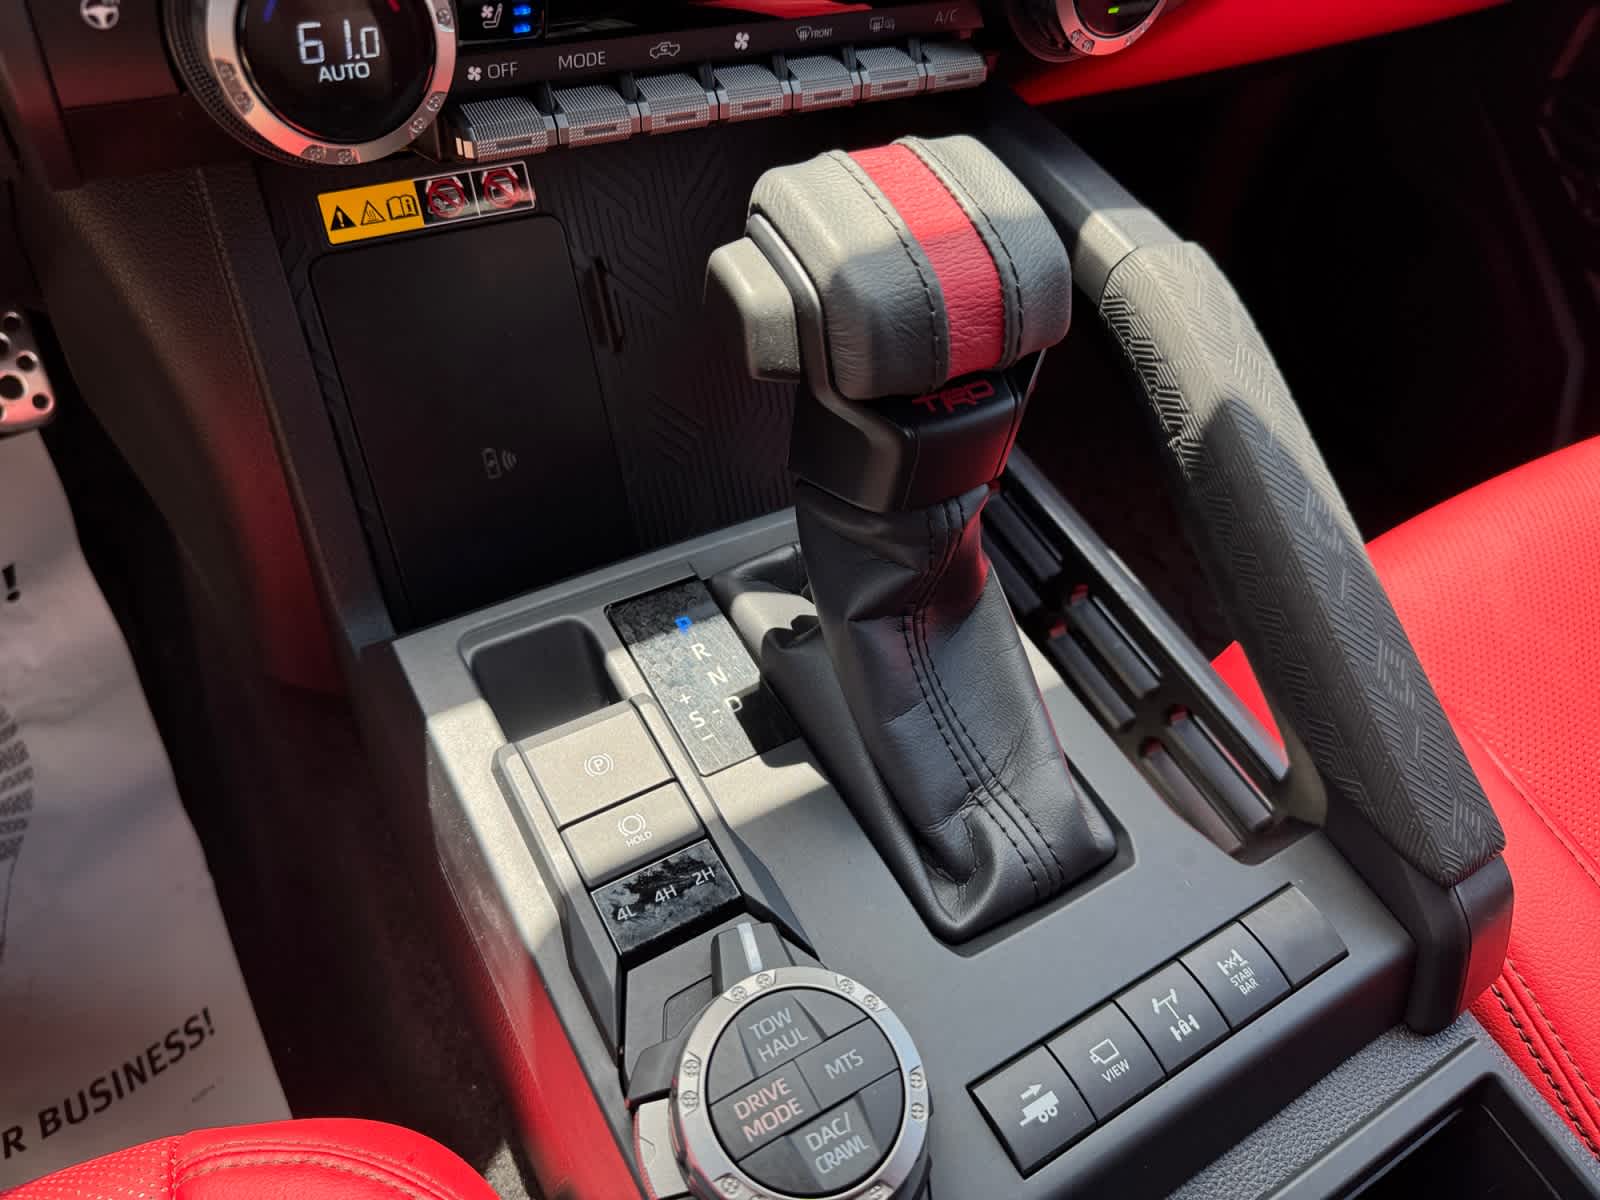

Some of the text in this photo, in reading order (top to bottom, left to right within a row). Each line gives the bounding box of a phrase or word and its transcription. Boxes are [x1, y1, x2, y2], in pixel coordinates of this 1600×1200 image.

[934, 8, 960, 25] A/C
[318, 61, 371, 83] AUTO
[487, 61, 520, 80] OFF
[558, 50, 607, 71] MODE
[911, 379, 996, 413] TRD
[691, 642, 712, 661] R
[706, 667, 729, 687] N
[725, 695, 743, 713] D
[688, 710, 706, 729] S
[625, 831, 653, 848] HOLD
[616, 865, 716, 922] 4L 4H 2H
[1230, 966, 1256, 987] STABI
[1239, 977, 1260, 995] BAR
[749, 1007, 792, 1041] TOW
[757, 1026, 809, 1063] HAUL
[37, 1006, 215, 1140] BUSINESS!
[824, 1048, 865, 1080] MTS
[1101, 1058, 1131, 1083] VIEW
[733, 1077, 792, 1121] DRIVE
[742, 1096, 804, 1143] MODE
[804, 1110, 851, 1152] DAC/
[815, 1134, 870, 1175] CRAWL
